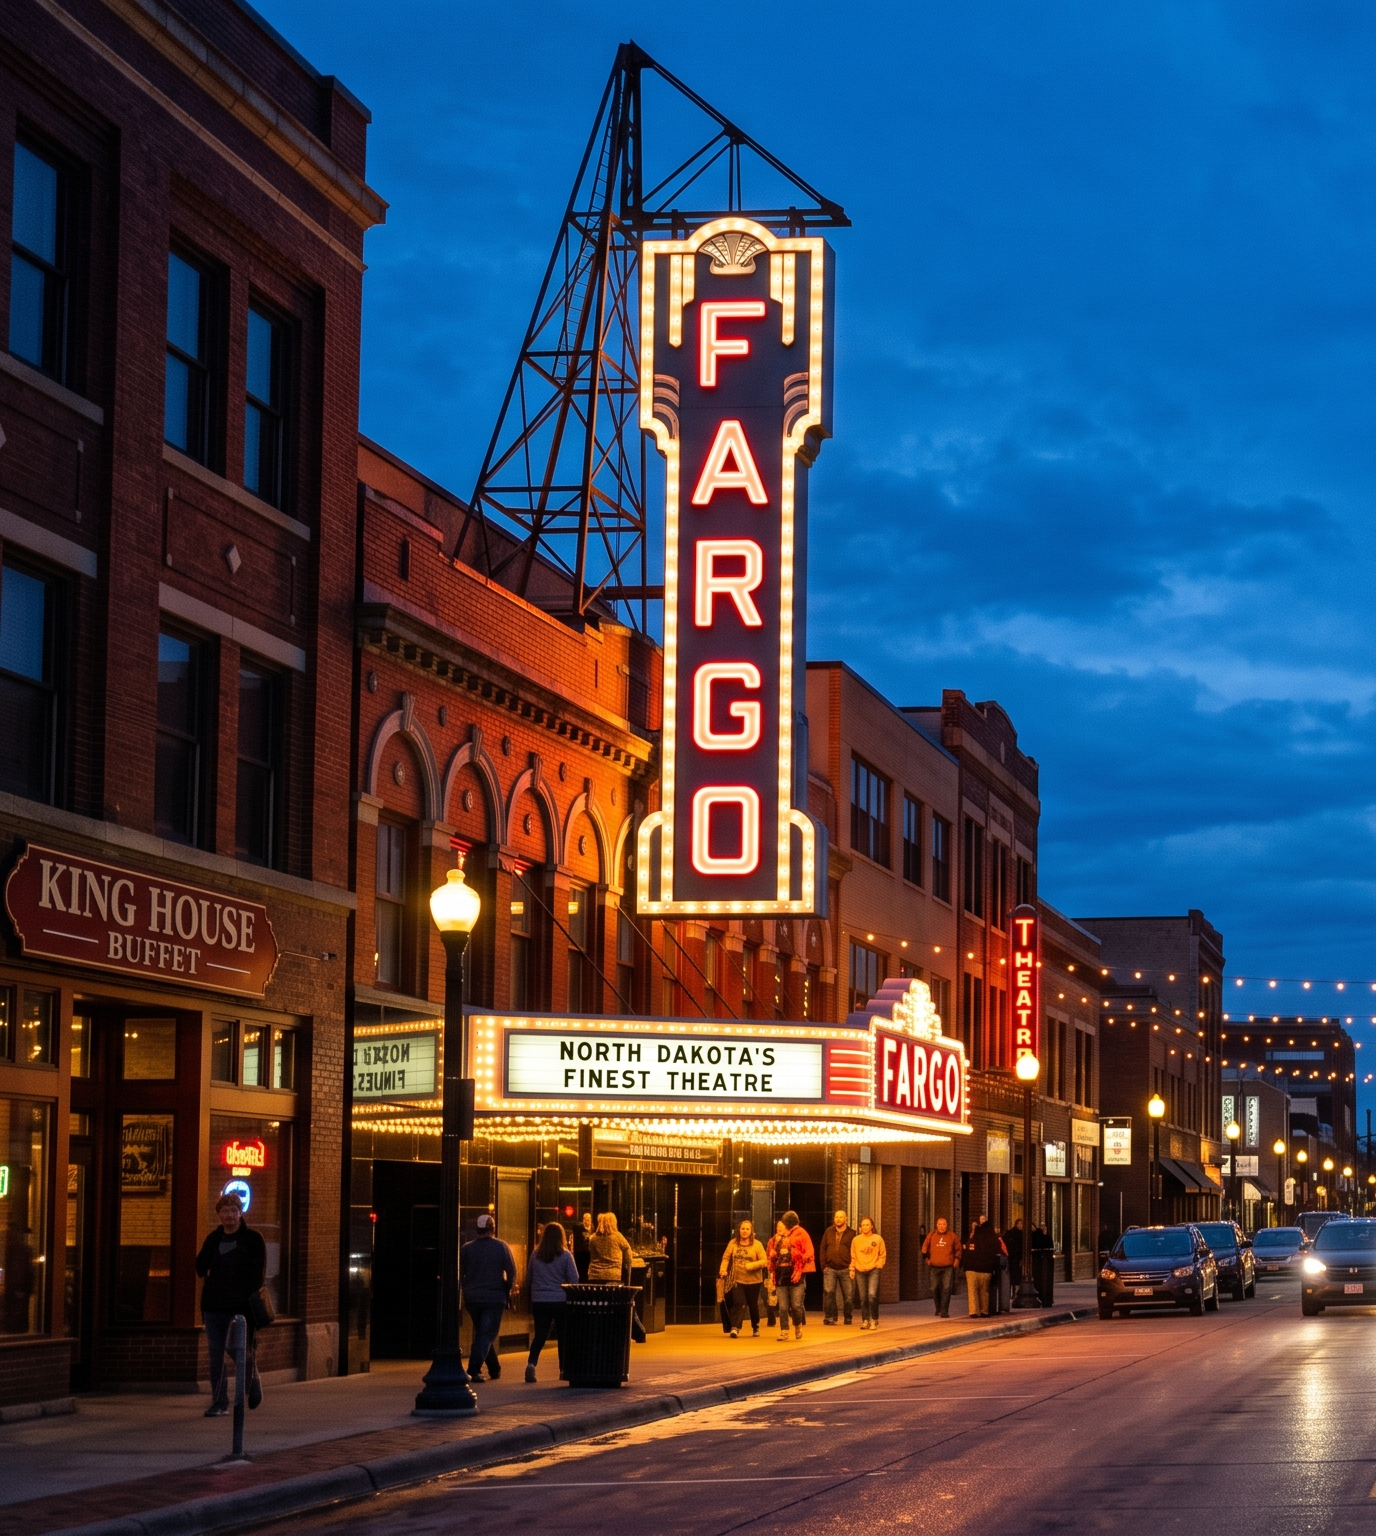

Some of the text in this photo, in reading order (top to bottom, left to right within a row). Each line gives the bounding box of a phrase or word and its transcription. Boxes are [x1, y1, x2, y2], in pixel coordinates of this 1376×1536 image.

[691, 300, 769, 876] FARGO
[38, 858, 256, 953] KING HOUSE
[107, 931, 201, 975] BUFFET
[560, 1040, 776, 1067] NORTH DAKOTA'S
[563, 1068, 773, 1093] FINEST THEATRE
[882, 1036, 960, 1115] FARGO
